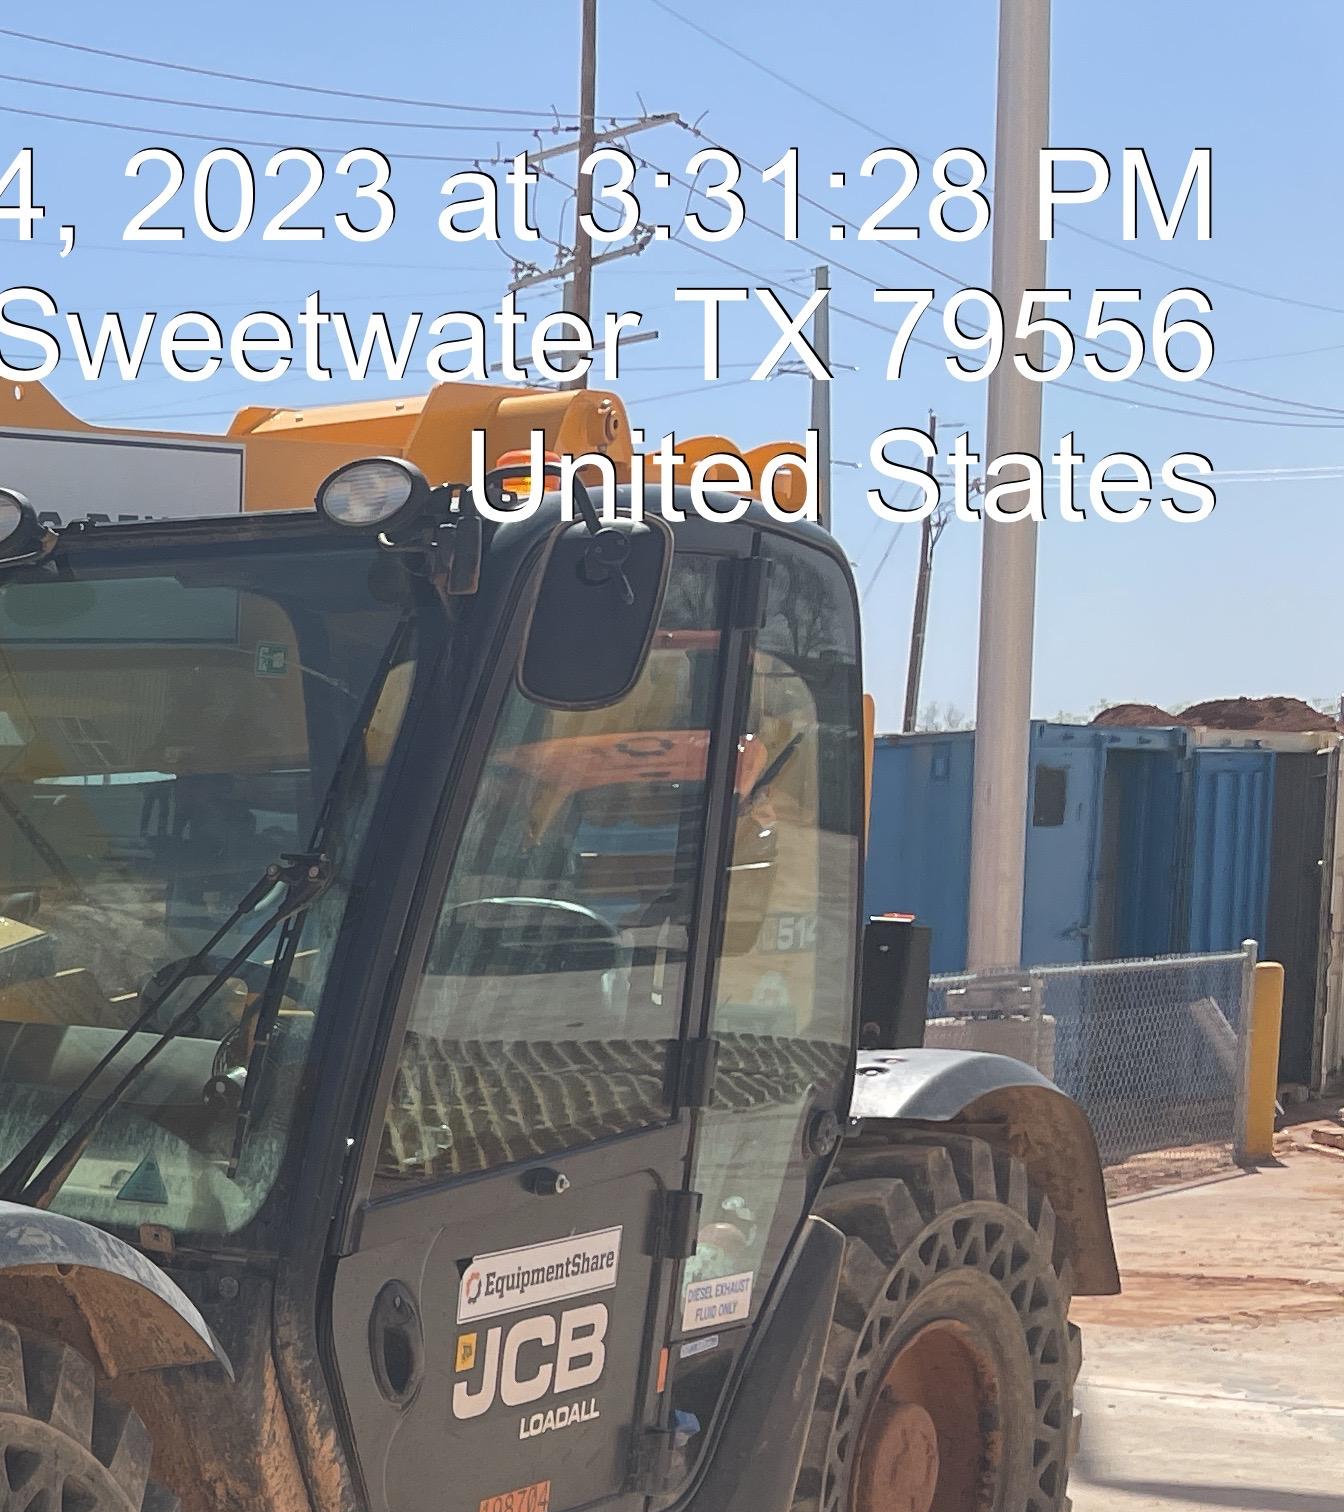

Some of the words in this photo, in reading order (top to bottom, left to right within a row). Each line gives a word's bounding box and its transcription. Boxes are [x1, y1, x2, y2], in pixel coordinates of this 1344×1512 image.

[484, 1250, 615, 1299] EquipmentShare
[687, 1286, 713, 1303] DIESEL
[715, 1278, 751, 1297] EXHAUST
[696, 1305, 717, 1321] FLUID
[718, 1301, 738, 1316] ONLY
[452, 1303, 609, 1420] JCB
[519, 1398, 600, 1440] LOADALL
